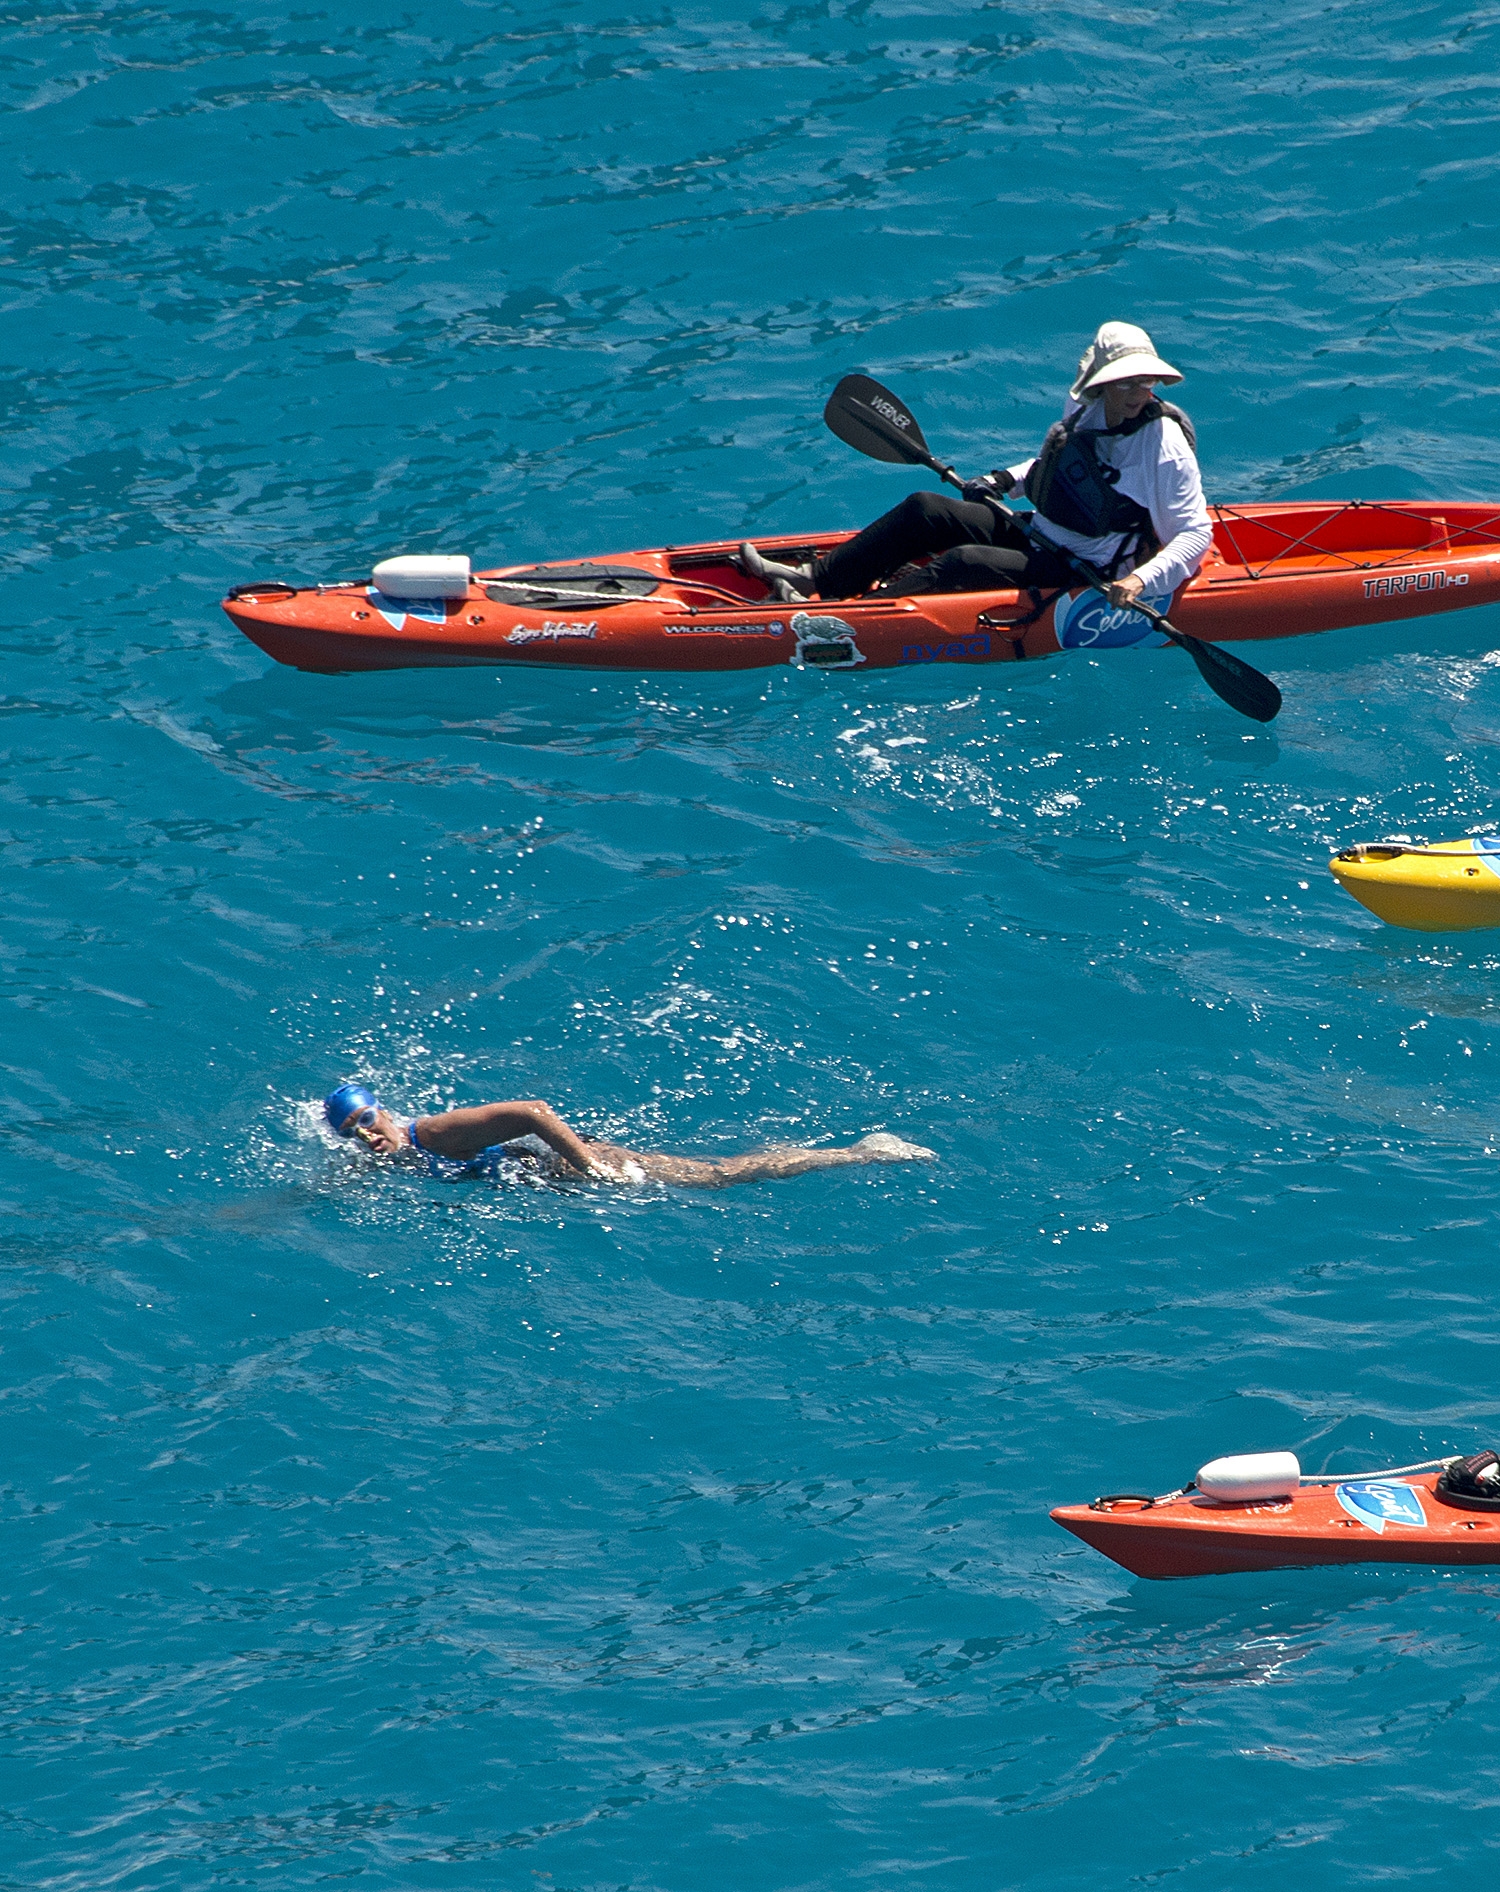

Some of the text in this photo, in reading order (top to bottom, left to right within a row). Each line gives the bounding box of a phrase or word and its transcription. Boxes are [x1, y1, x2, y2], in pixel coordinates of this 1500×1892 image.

[870, 395, 912, 430] WERNER
[1363, 569, 1445, 598] TARPON
[663, 624, 766, 635] WILDERNESS
[897, 633, 991, 663] nyad
